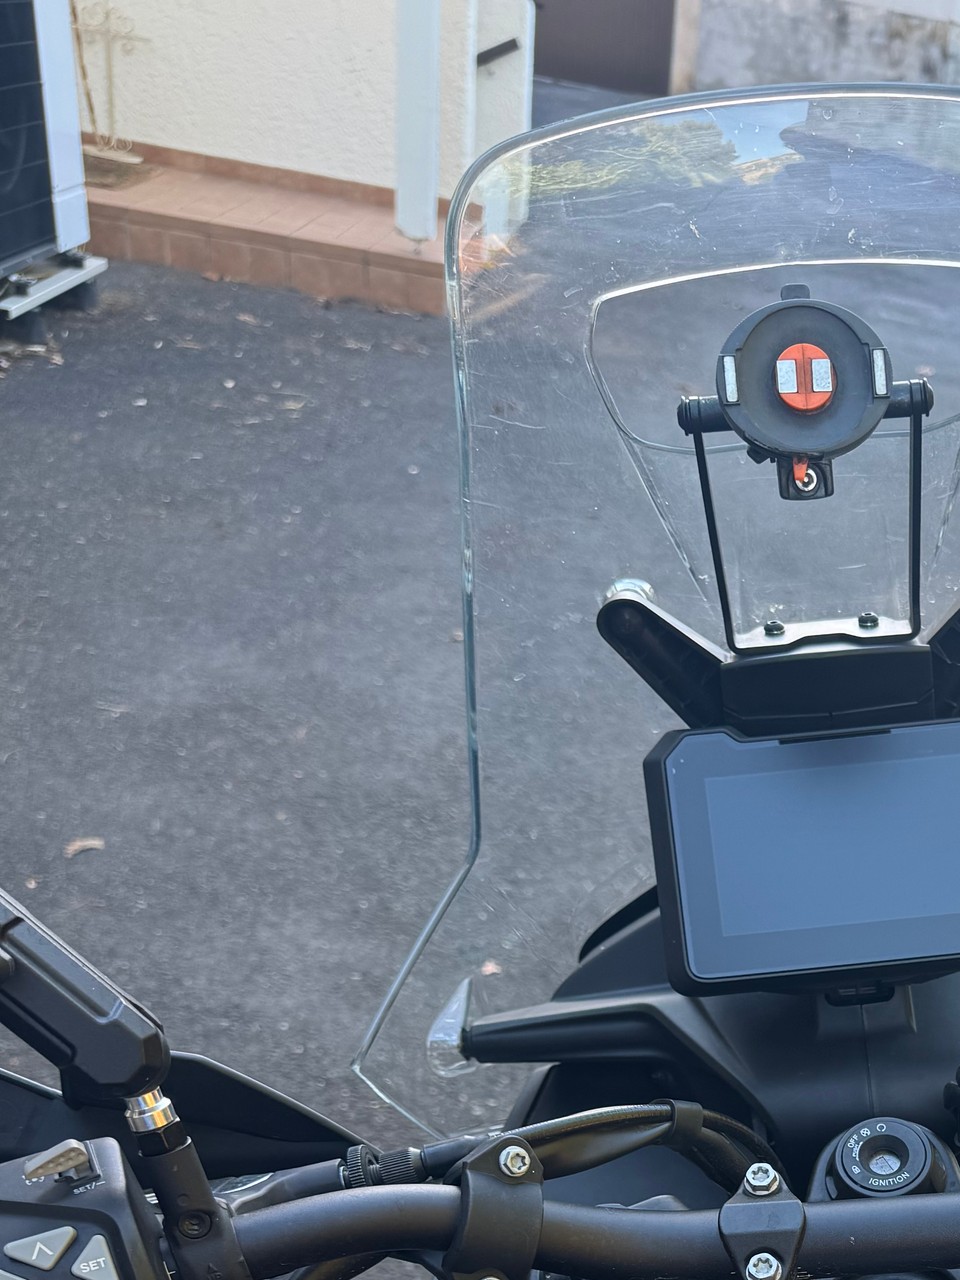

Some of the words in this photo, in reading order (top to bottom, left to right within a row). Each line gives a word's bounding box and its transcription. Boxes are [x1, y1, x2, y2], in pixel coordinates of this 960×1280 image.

[847, 1134, 858, 1148] OFF
[868, 1171, 910, 1186] IGNITION
[80, 1257, 106, 1273] SET
